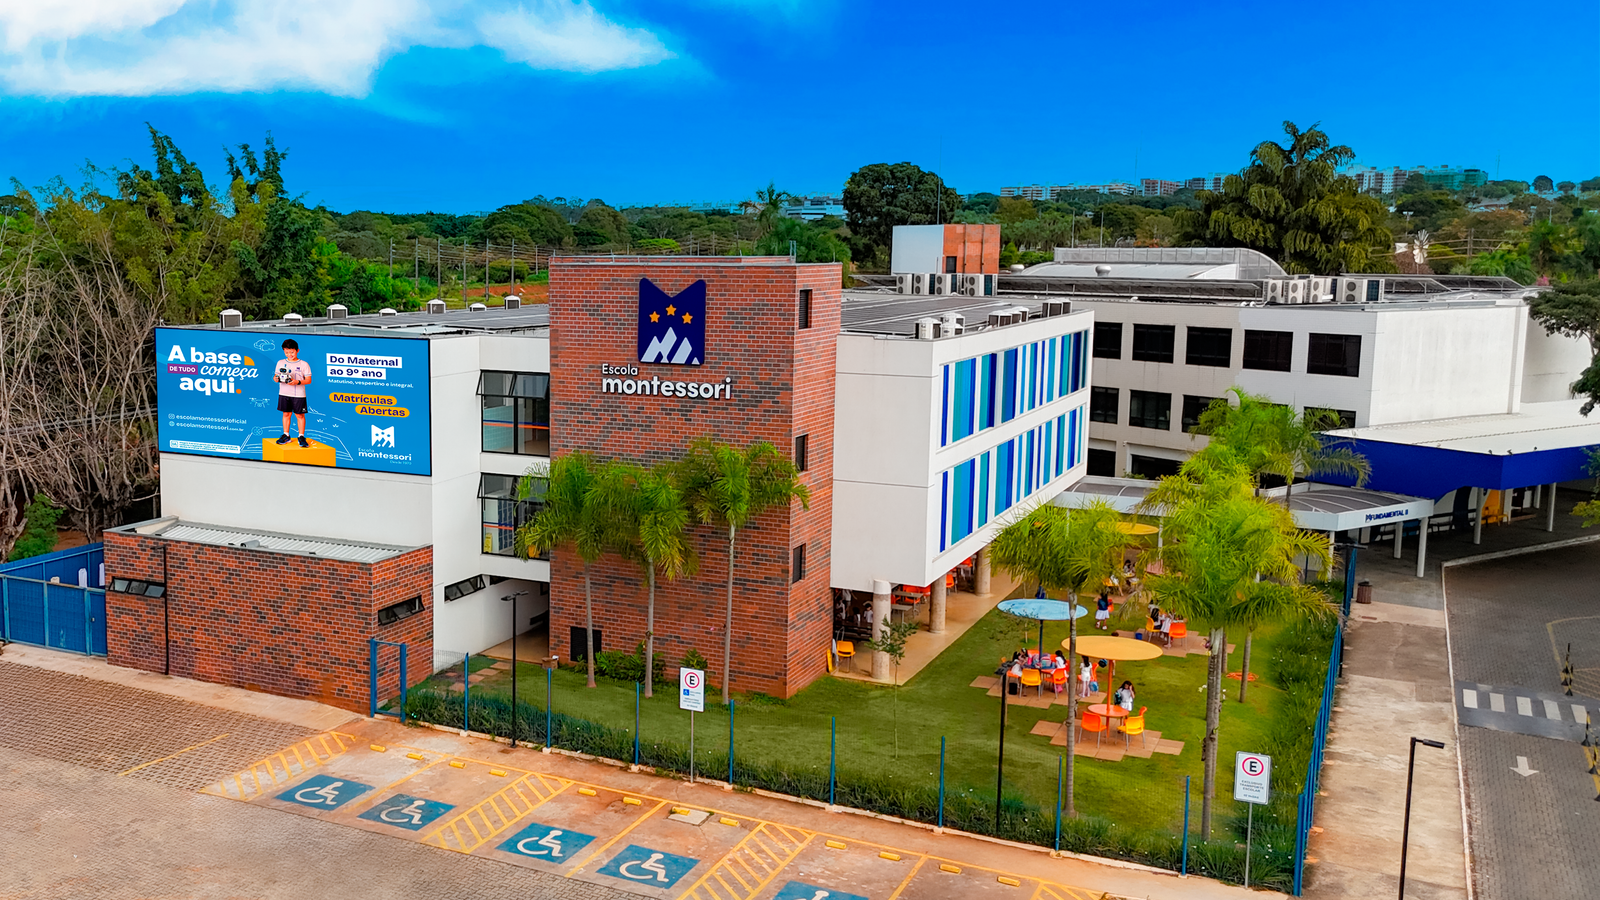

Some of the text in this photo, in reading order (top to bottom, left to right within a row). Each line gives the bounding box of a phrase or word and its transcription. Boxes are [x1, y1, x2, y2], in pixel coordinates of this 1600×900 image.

[167, 345, 242, 365] A base
[329, 355, 399, 367] Do Maternal
[200, 365, 259, 380] começa
[329, 368, 344, 376] ao
[361, 370, 383, 378] ano
[602, 363, 639, 376] Escola
[179, 377, 242, 396] aqui.
[602, 375, 732, 400] montessori
[333, 394, 393, 405] Matrículas
[360, 406, 406, 417] Abertas
[176, 414, 247, 424] escolamontessorioficial
[358, 451, 412, 461] montessori
[689, 675, 695, 685] E
[1249, 761, 1258, 772] E
